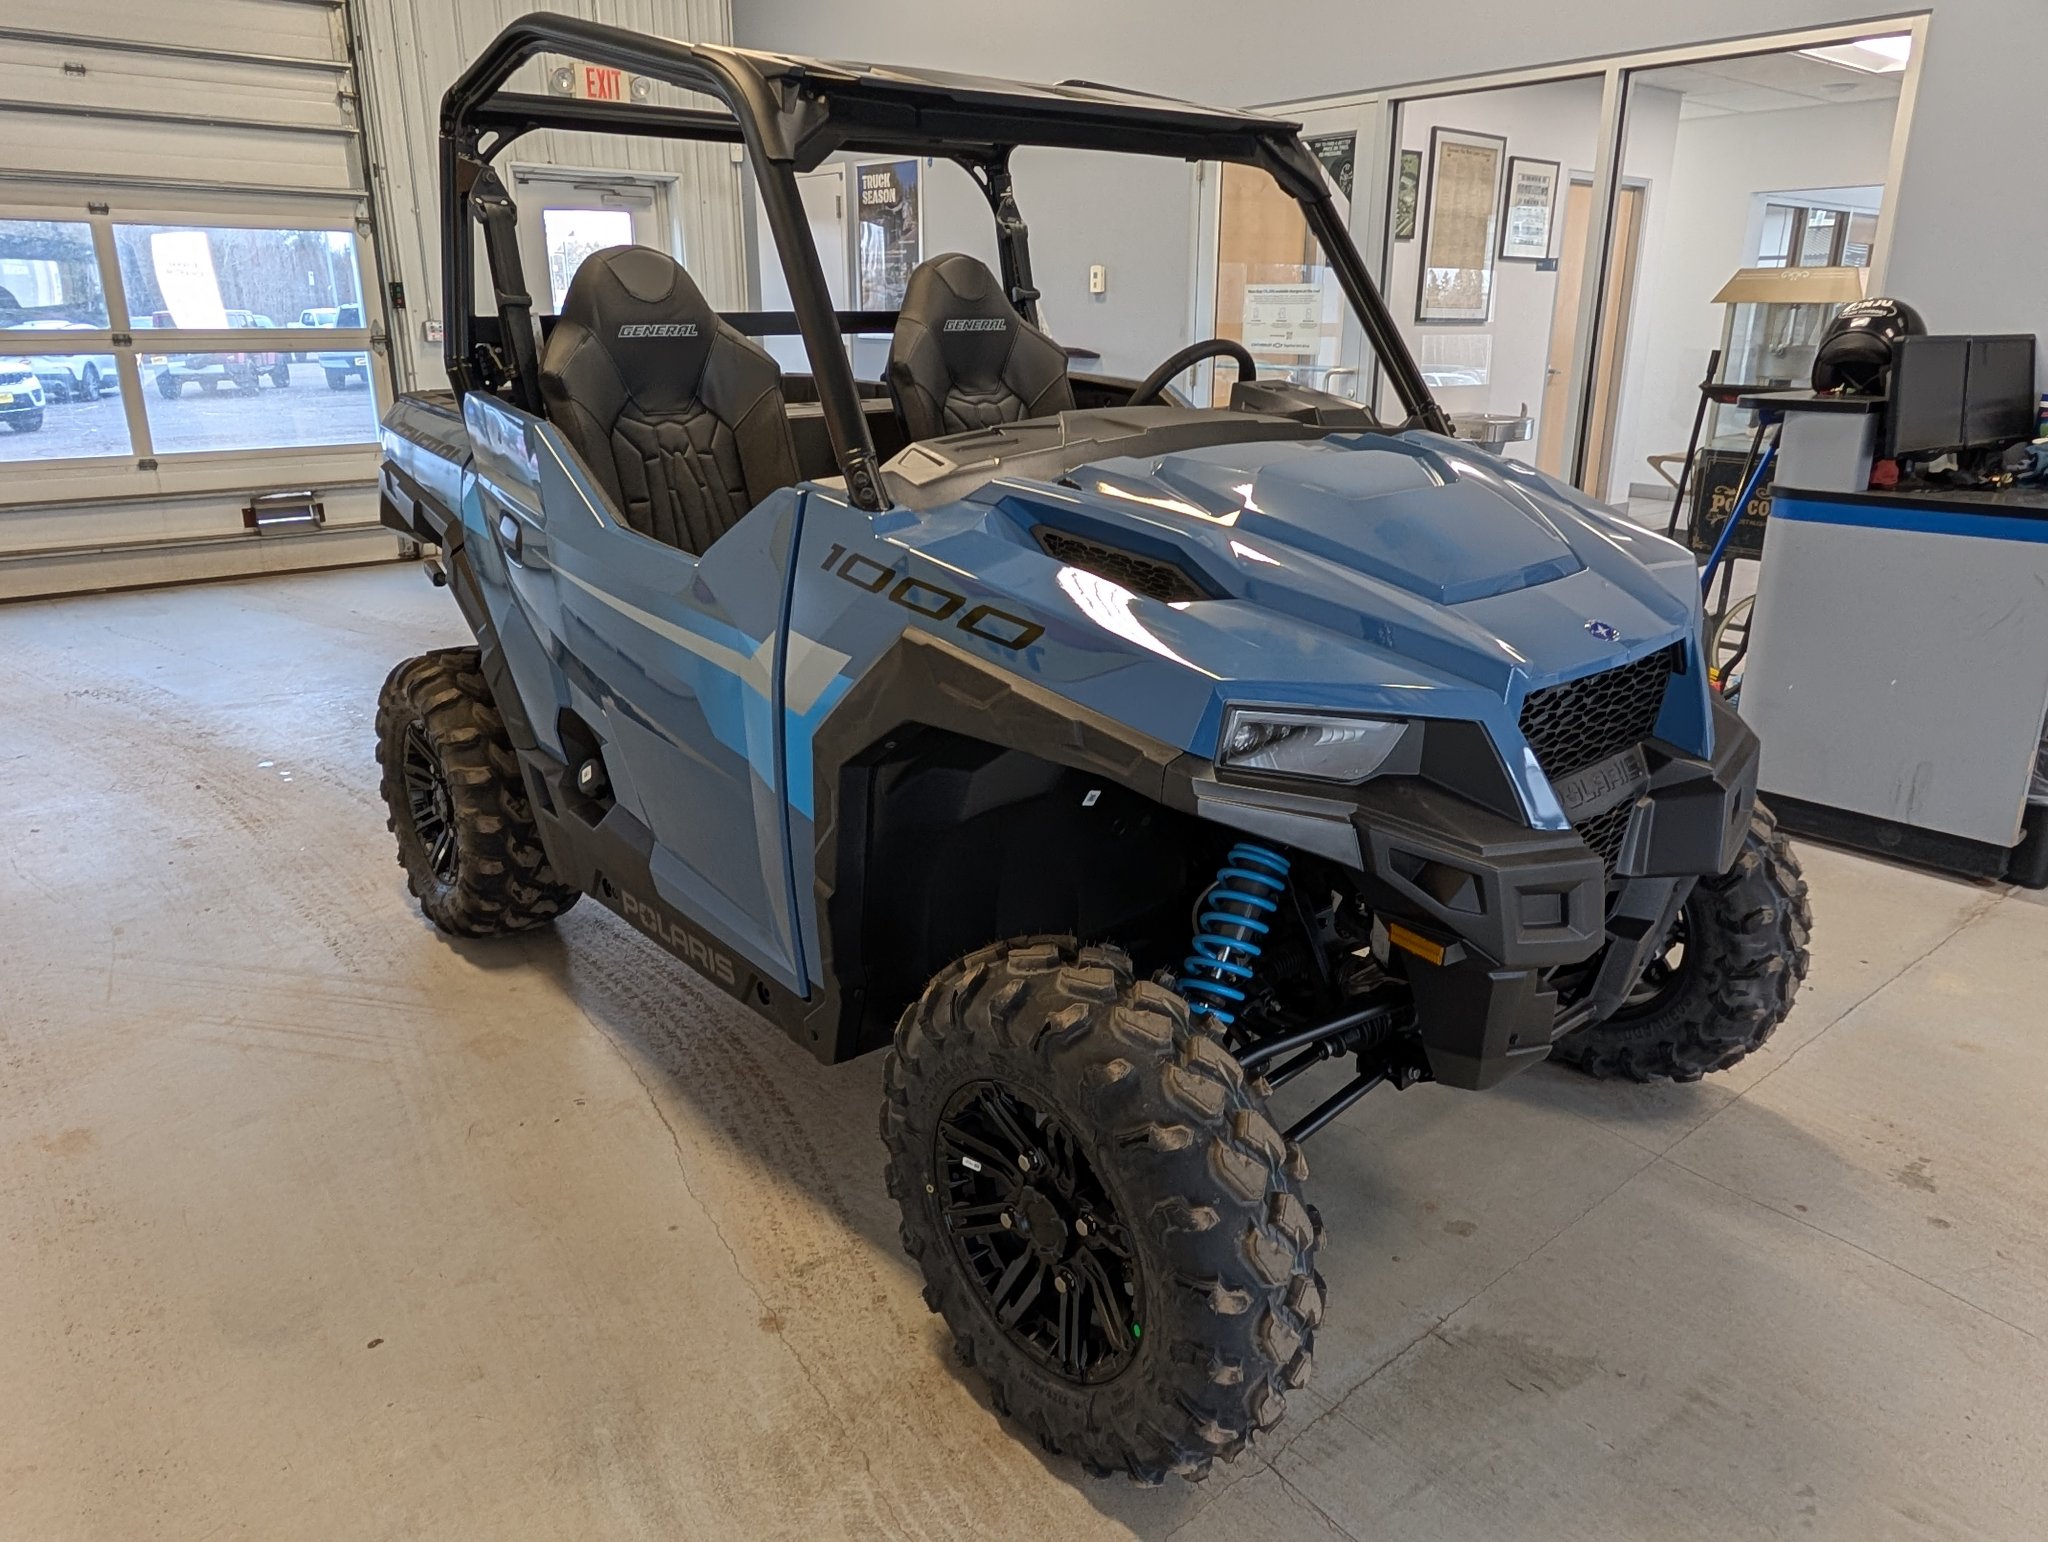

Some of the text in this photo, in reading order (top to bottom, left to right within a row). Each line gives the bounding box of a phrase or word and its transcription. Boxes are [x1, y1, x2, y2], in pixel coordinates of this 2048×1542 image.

[586, 67, 621, 100] EXIT
[861, 172, 891, 190] TRUCK
[862, 187, 896, 205] SEASON
[618, 324, 698, 338] GENERAL
[943, 319, 1006, 331] GENERAL
[820, 543, 1046, 651] 1000
[621, 890, 735, 985] POLARIS
